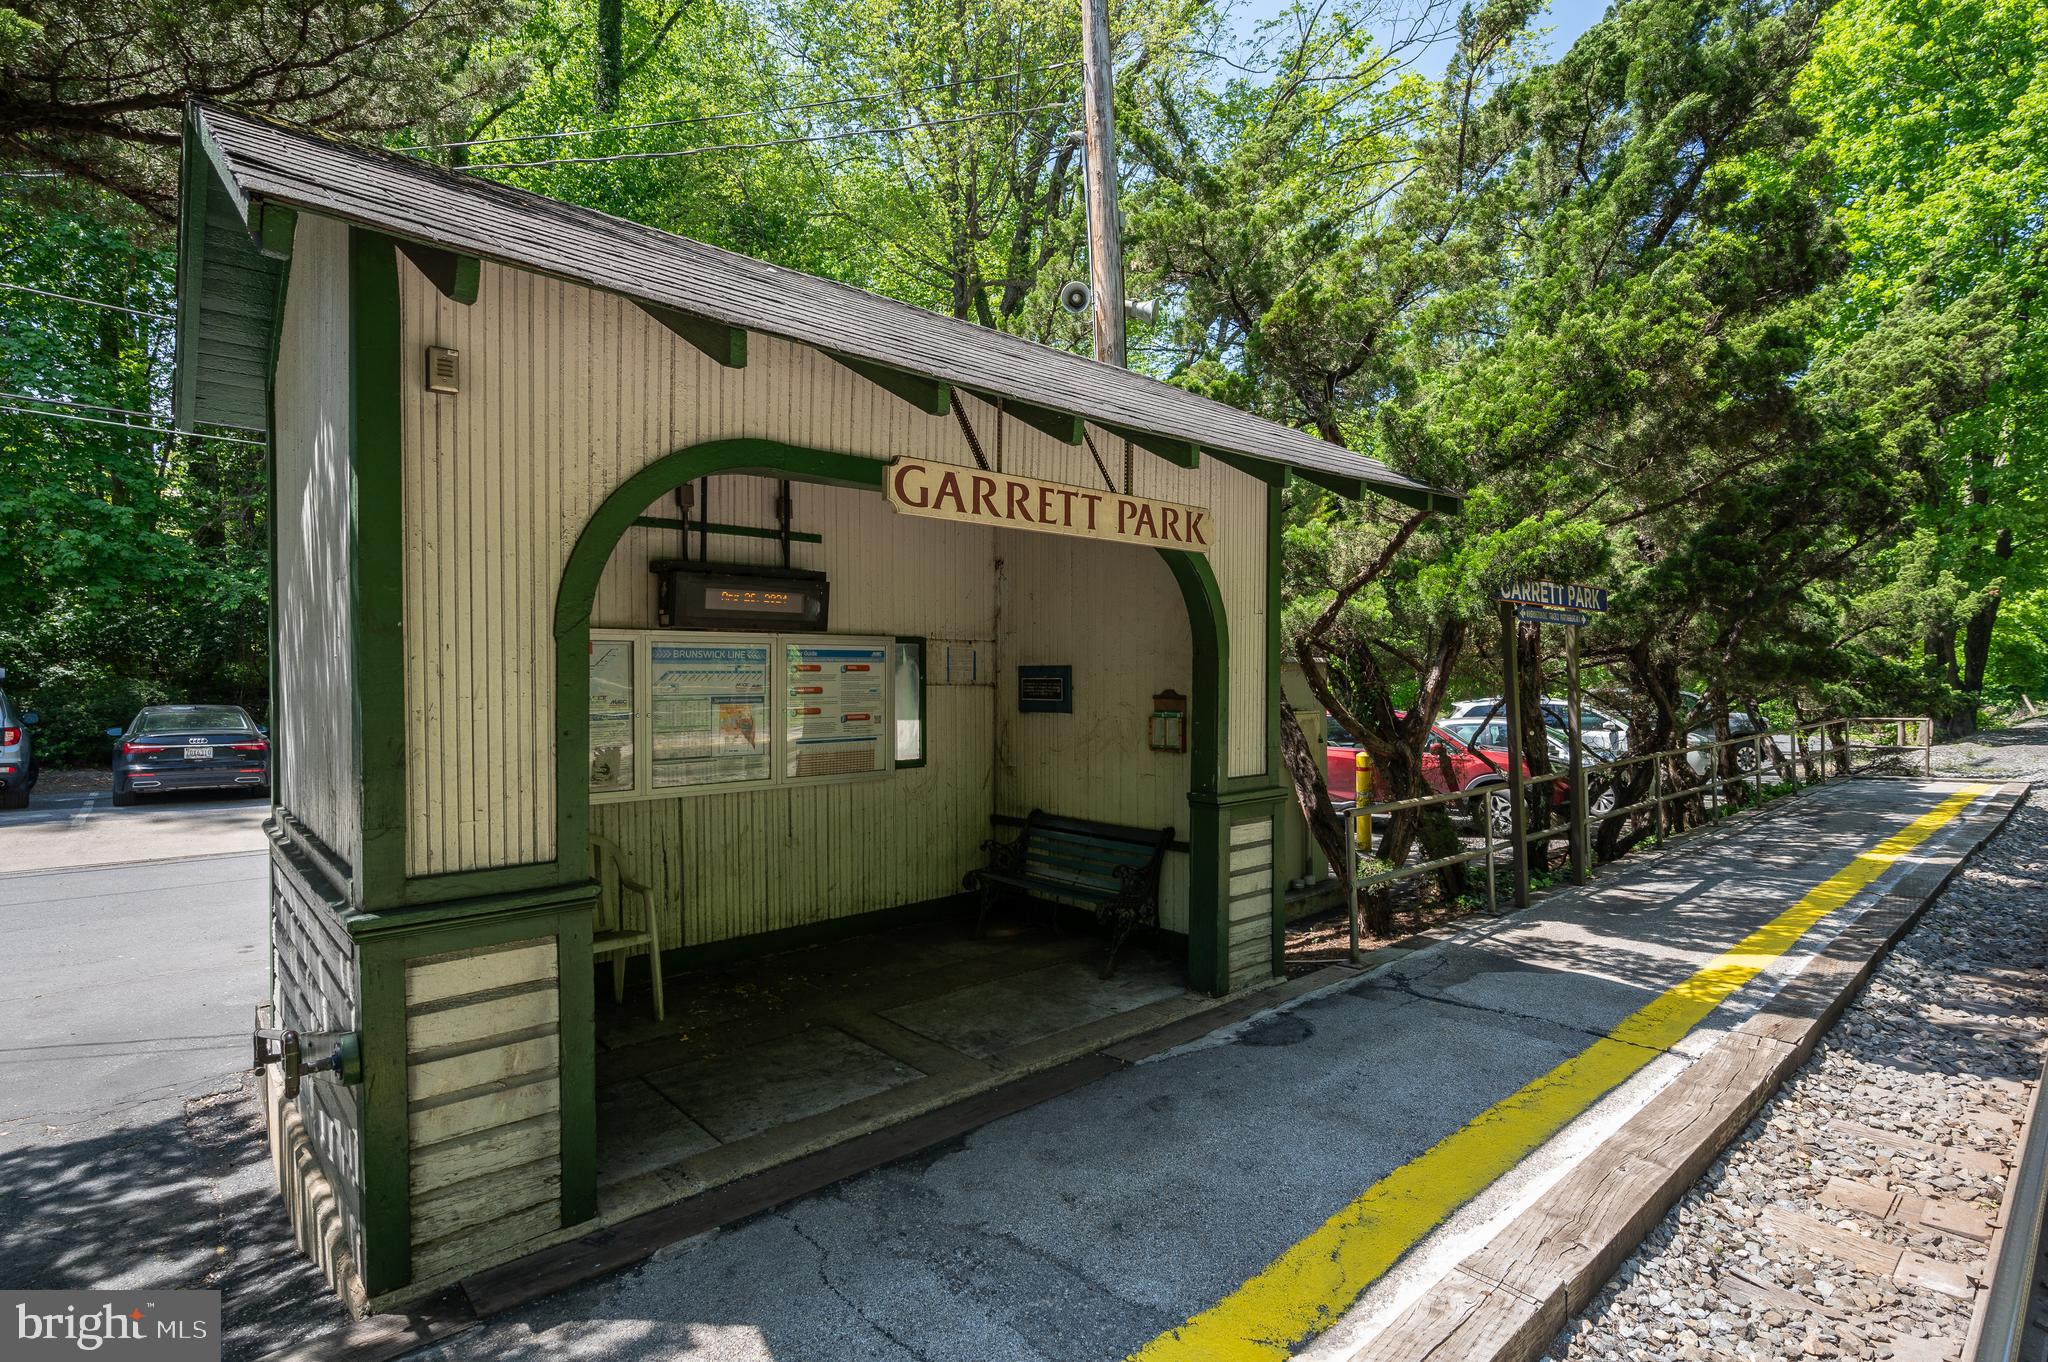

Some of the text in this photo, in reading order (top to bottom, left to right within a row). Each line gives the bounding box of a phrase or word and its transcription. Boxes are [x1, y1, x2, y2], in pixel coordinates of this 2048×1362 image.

[894, 464, 1207, 545] GARRETT PARK
[1568, 585, 1600, 609] PARK
[673, 649, 746, 659] BRUNSWICK LINE
